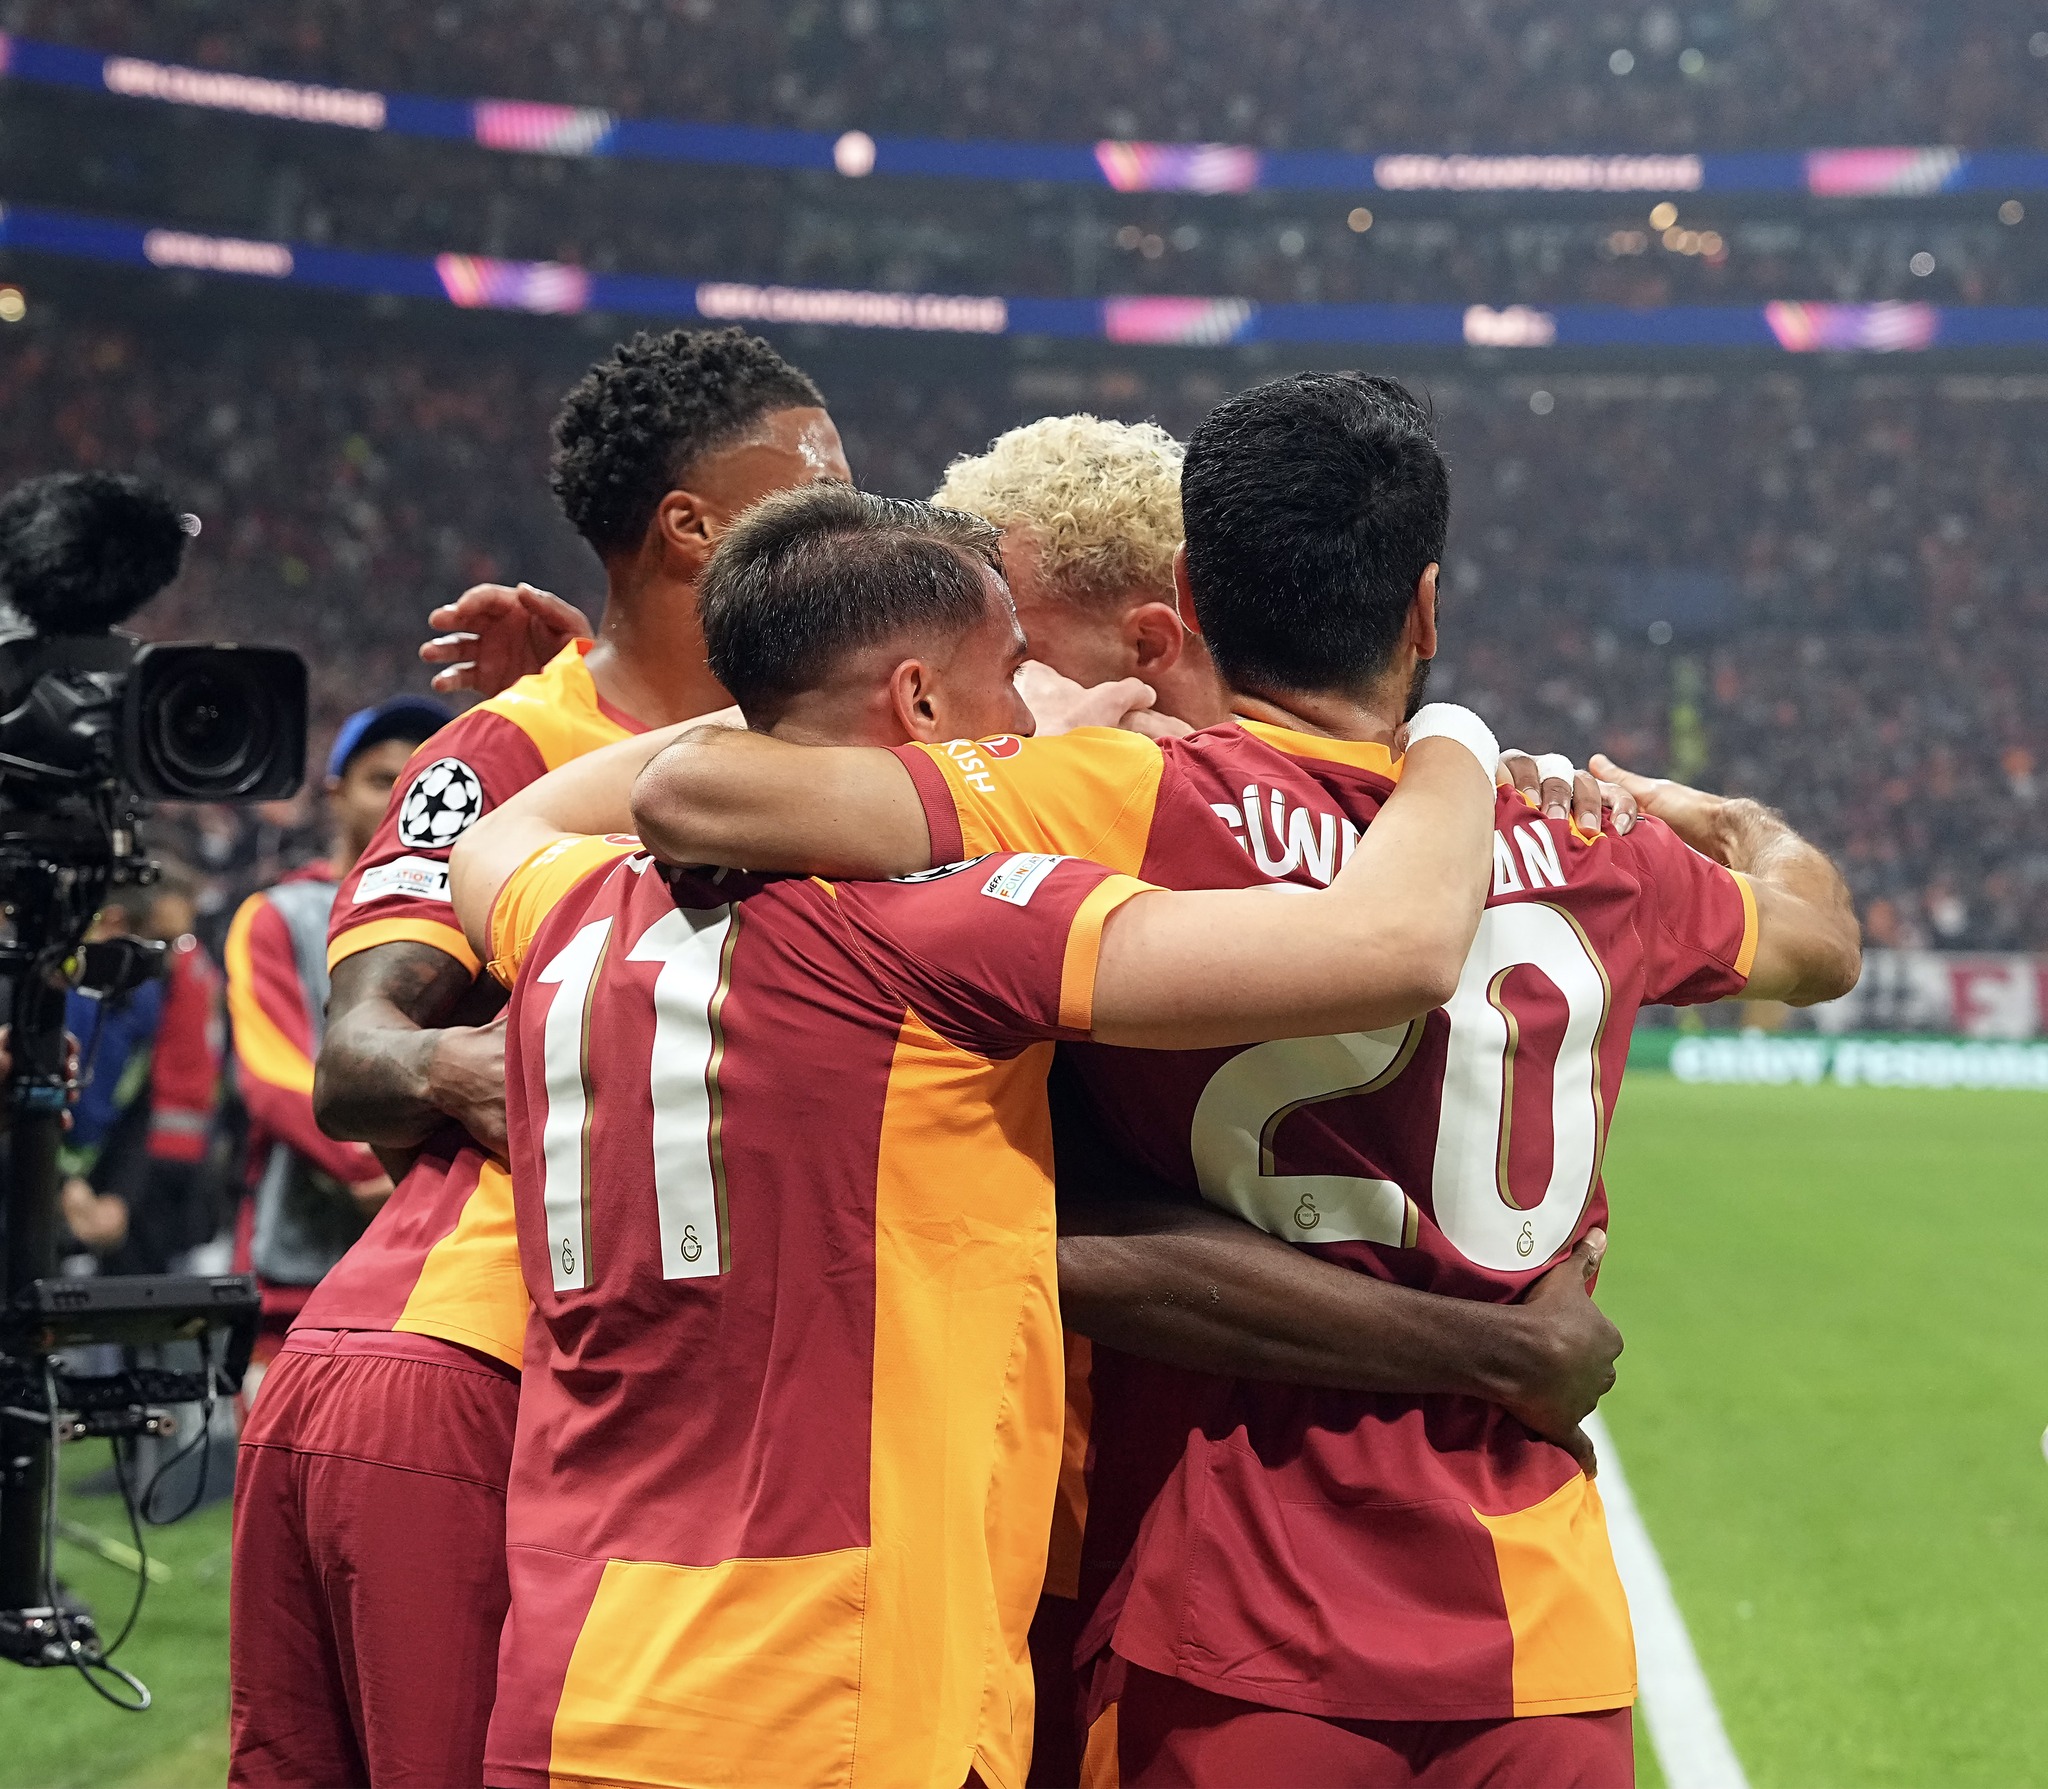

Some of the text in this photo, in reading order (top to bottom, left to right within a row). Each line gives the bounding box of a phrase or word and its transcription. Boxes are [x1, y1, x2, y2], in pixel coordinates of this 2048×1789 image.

[941, 738, 996, 792] KISH
[536, 901, 741, 1292] 11
[1190, 886, 1612, 1272] 20
